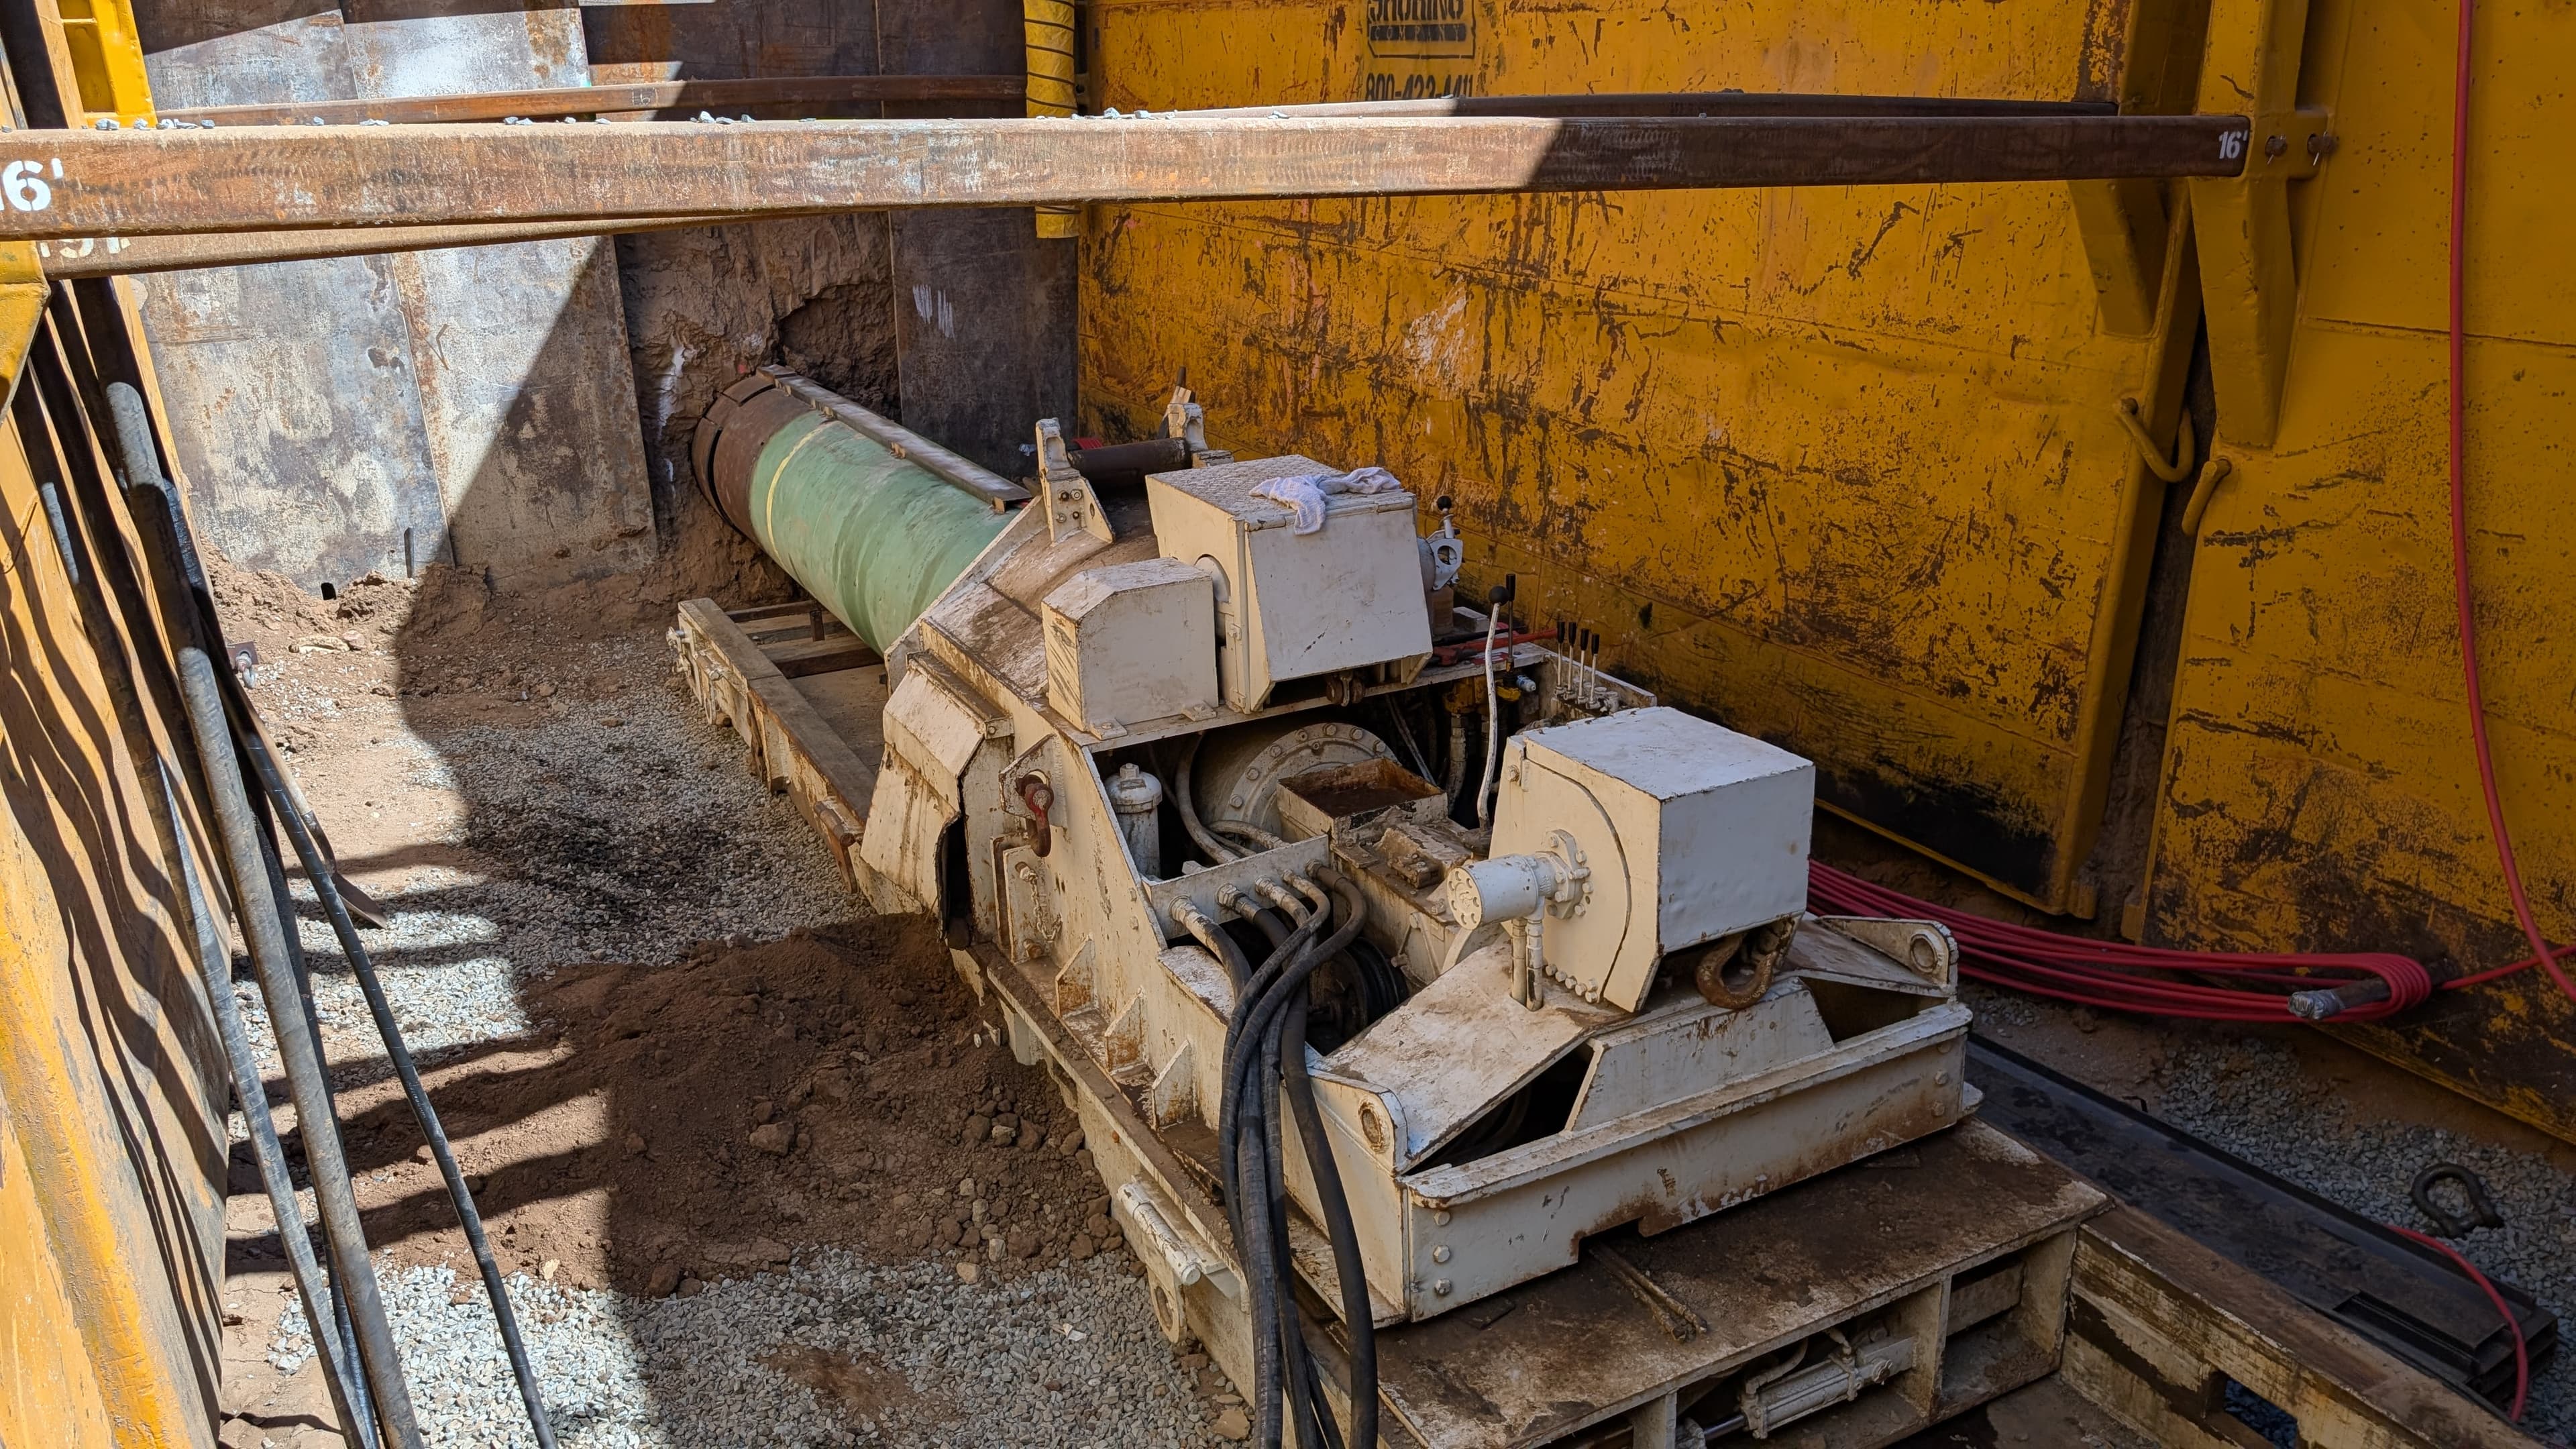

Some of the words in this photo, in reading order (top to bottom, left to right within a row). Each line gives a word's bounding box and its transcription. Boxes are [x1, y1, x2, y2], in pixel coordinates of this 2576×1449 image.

[1375, 25, 1460, 42] COMPANY
[2218, 129, 2248, 159] 16'
[0, 158, 64, 211] 6'
